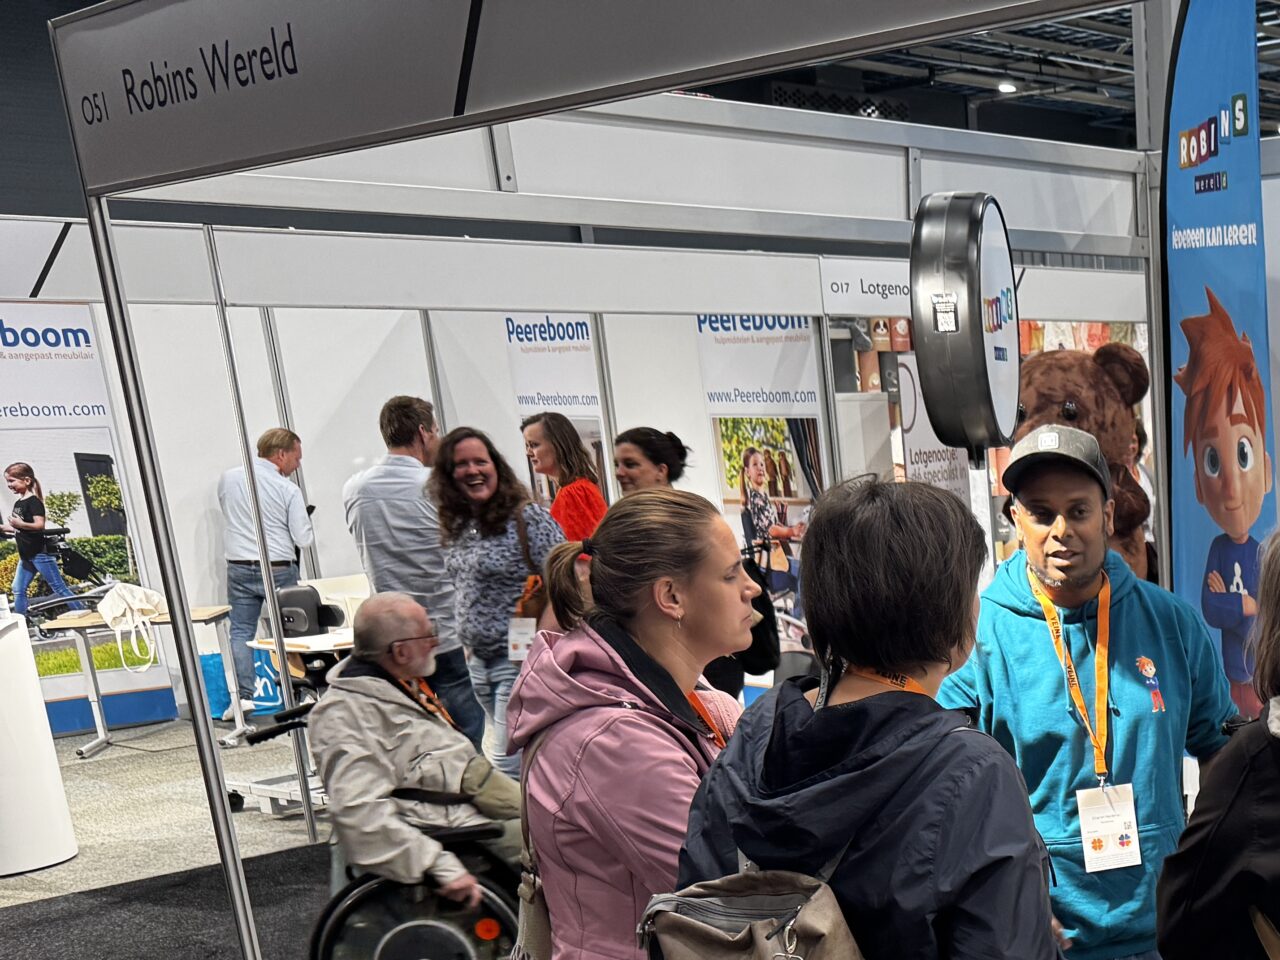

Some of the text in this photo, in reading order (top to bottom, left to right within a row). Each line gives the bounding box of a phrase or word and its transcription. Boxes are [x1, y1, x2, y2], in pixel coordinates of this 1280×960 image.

[121, 60, 198, 115] Robins
[199, 22, 298, 94] Wereld
[1180, 96, 1247, 166] ROBINS
[1195, 173, 1227, 193] wereld
[860, 278, 910, 300] Lotgeno
[0, 319, 91, 348] boom
[505, 315, 590, 343] Peereboom
[8, 351, 54, 362] aangepast
[54, 350, 95, 360] meubilair
[517, 392, 599, 406] www.Peereboom.com
[707, 387, 817, 403] www.Peereboom.com
